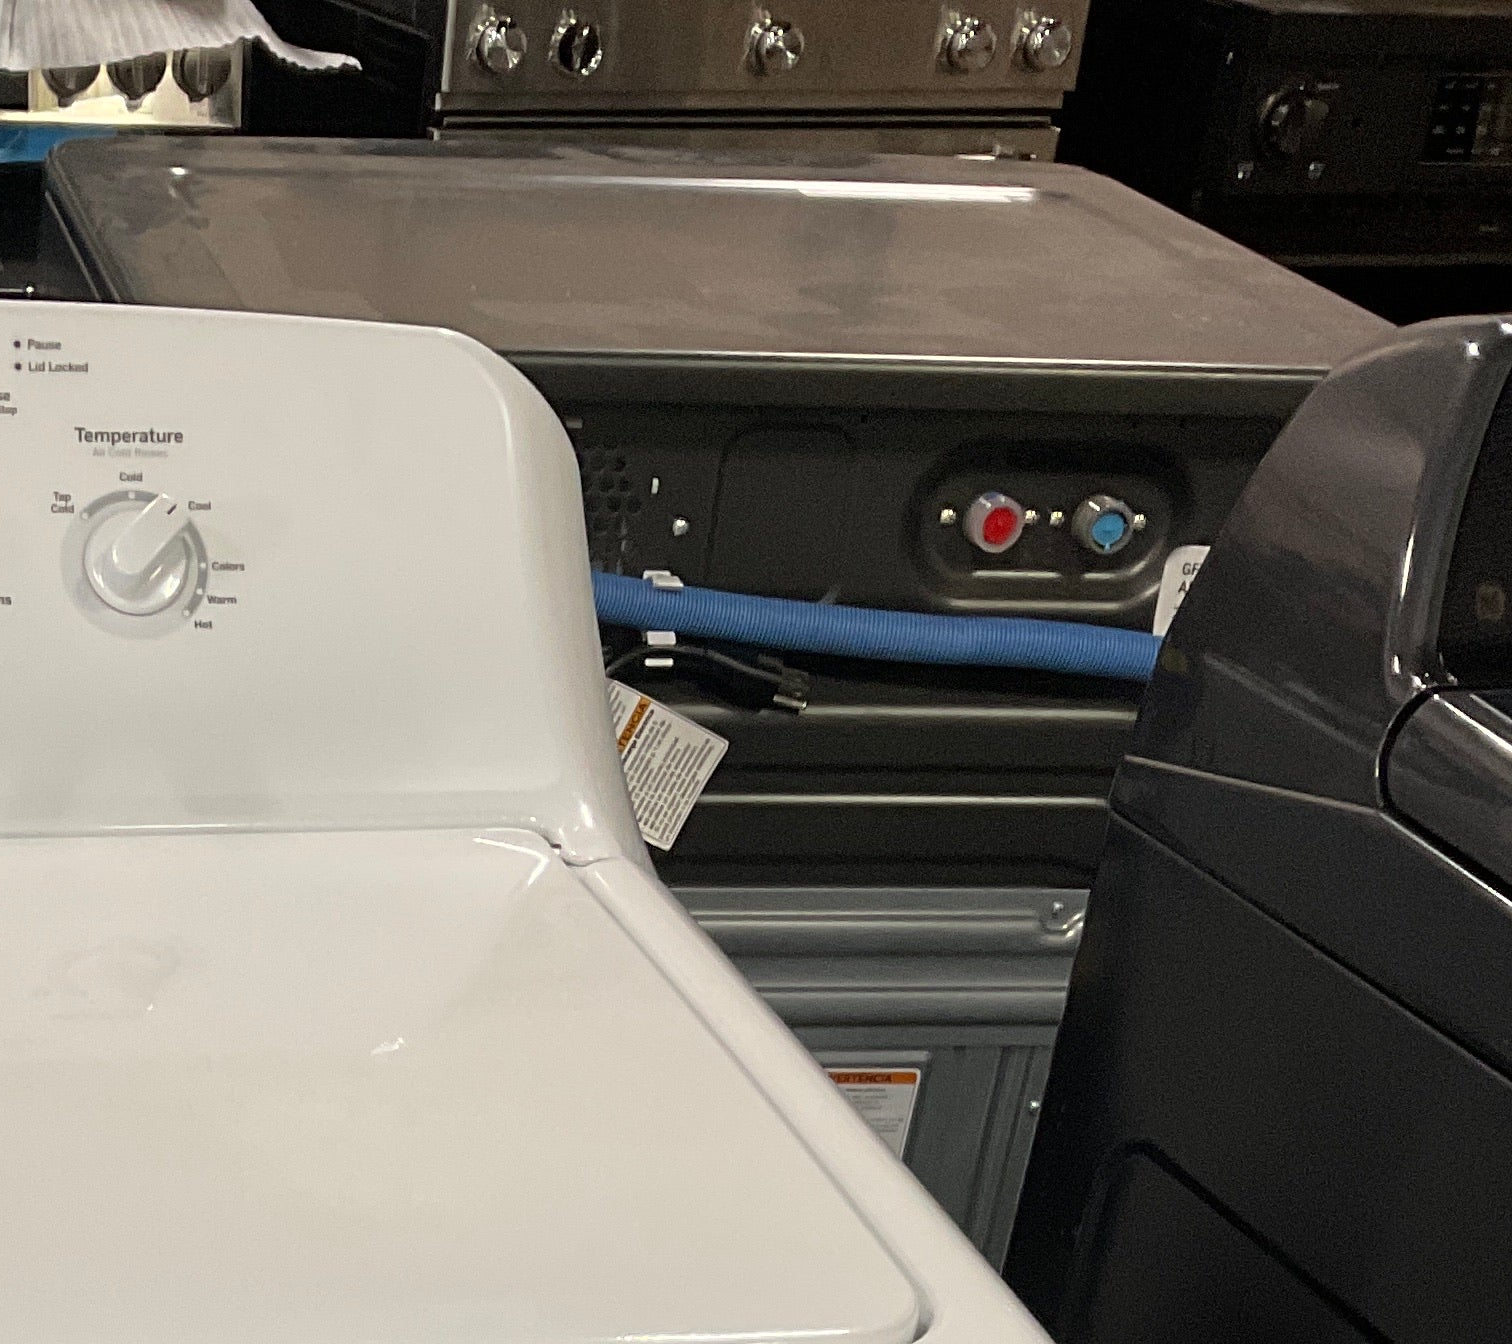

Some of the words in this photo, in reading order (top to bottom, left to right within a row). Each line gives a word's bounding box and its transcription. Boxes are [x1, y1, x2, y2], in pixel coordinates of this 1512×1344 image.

[28, 339, 62, 351] Pause
[28, 362, 45, 372] Lid
[49, 362, 88, 373] Locked
[74, 427, 184, 446] Temperature
[119, 472, 144, 482] Cold
[51, 503, 75, 514] Cold
[188, 501, 212, 511] Cool
[211, 562, 245, 572] Colors
[207, 595, 237, 604] Warm
[194, 621, 213, 629] Hot
